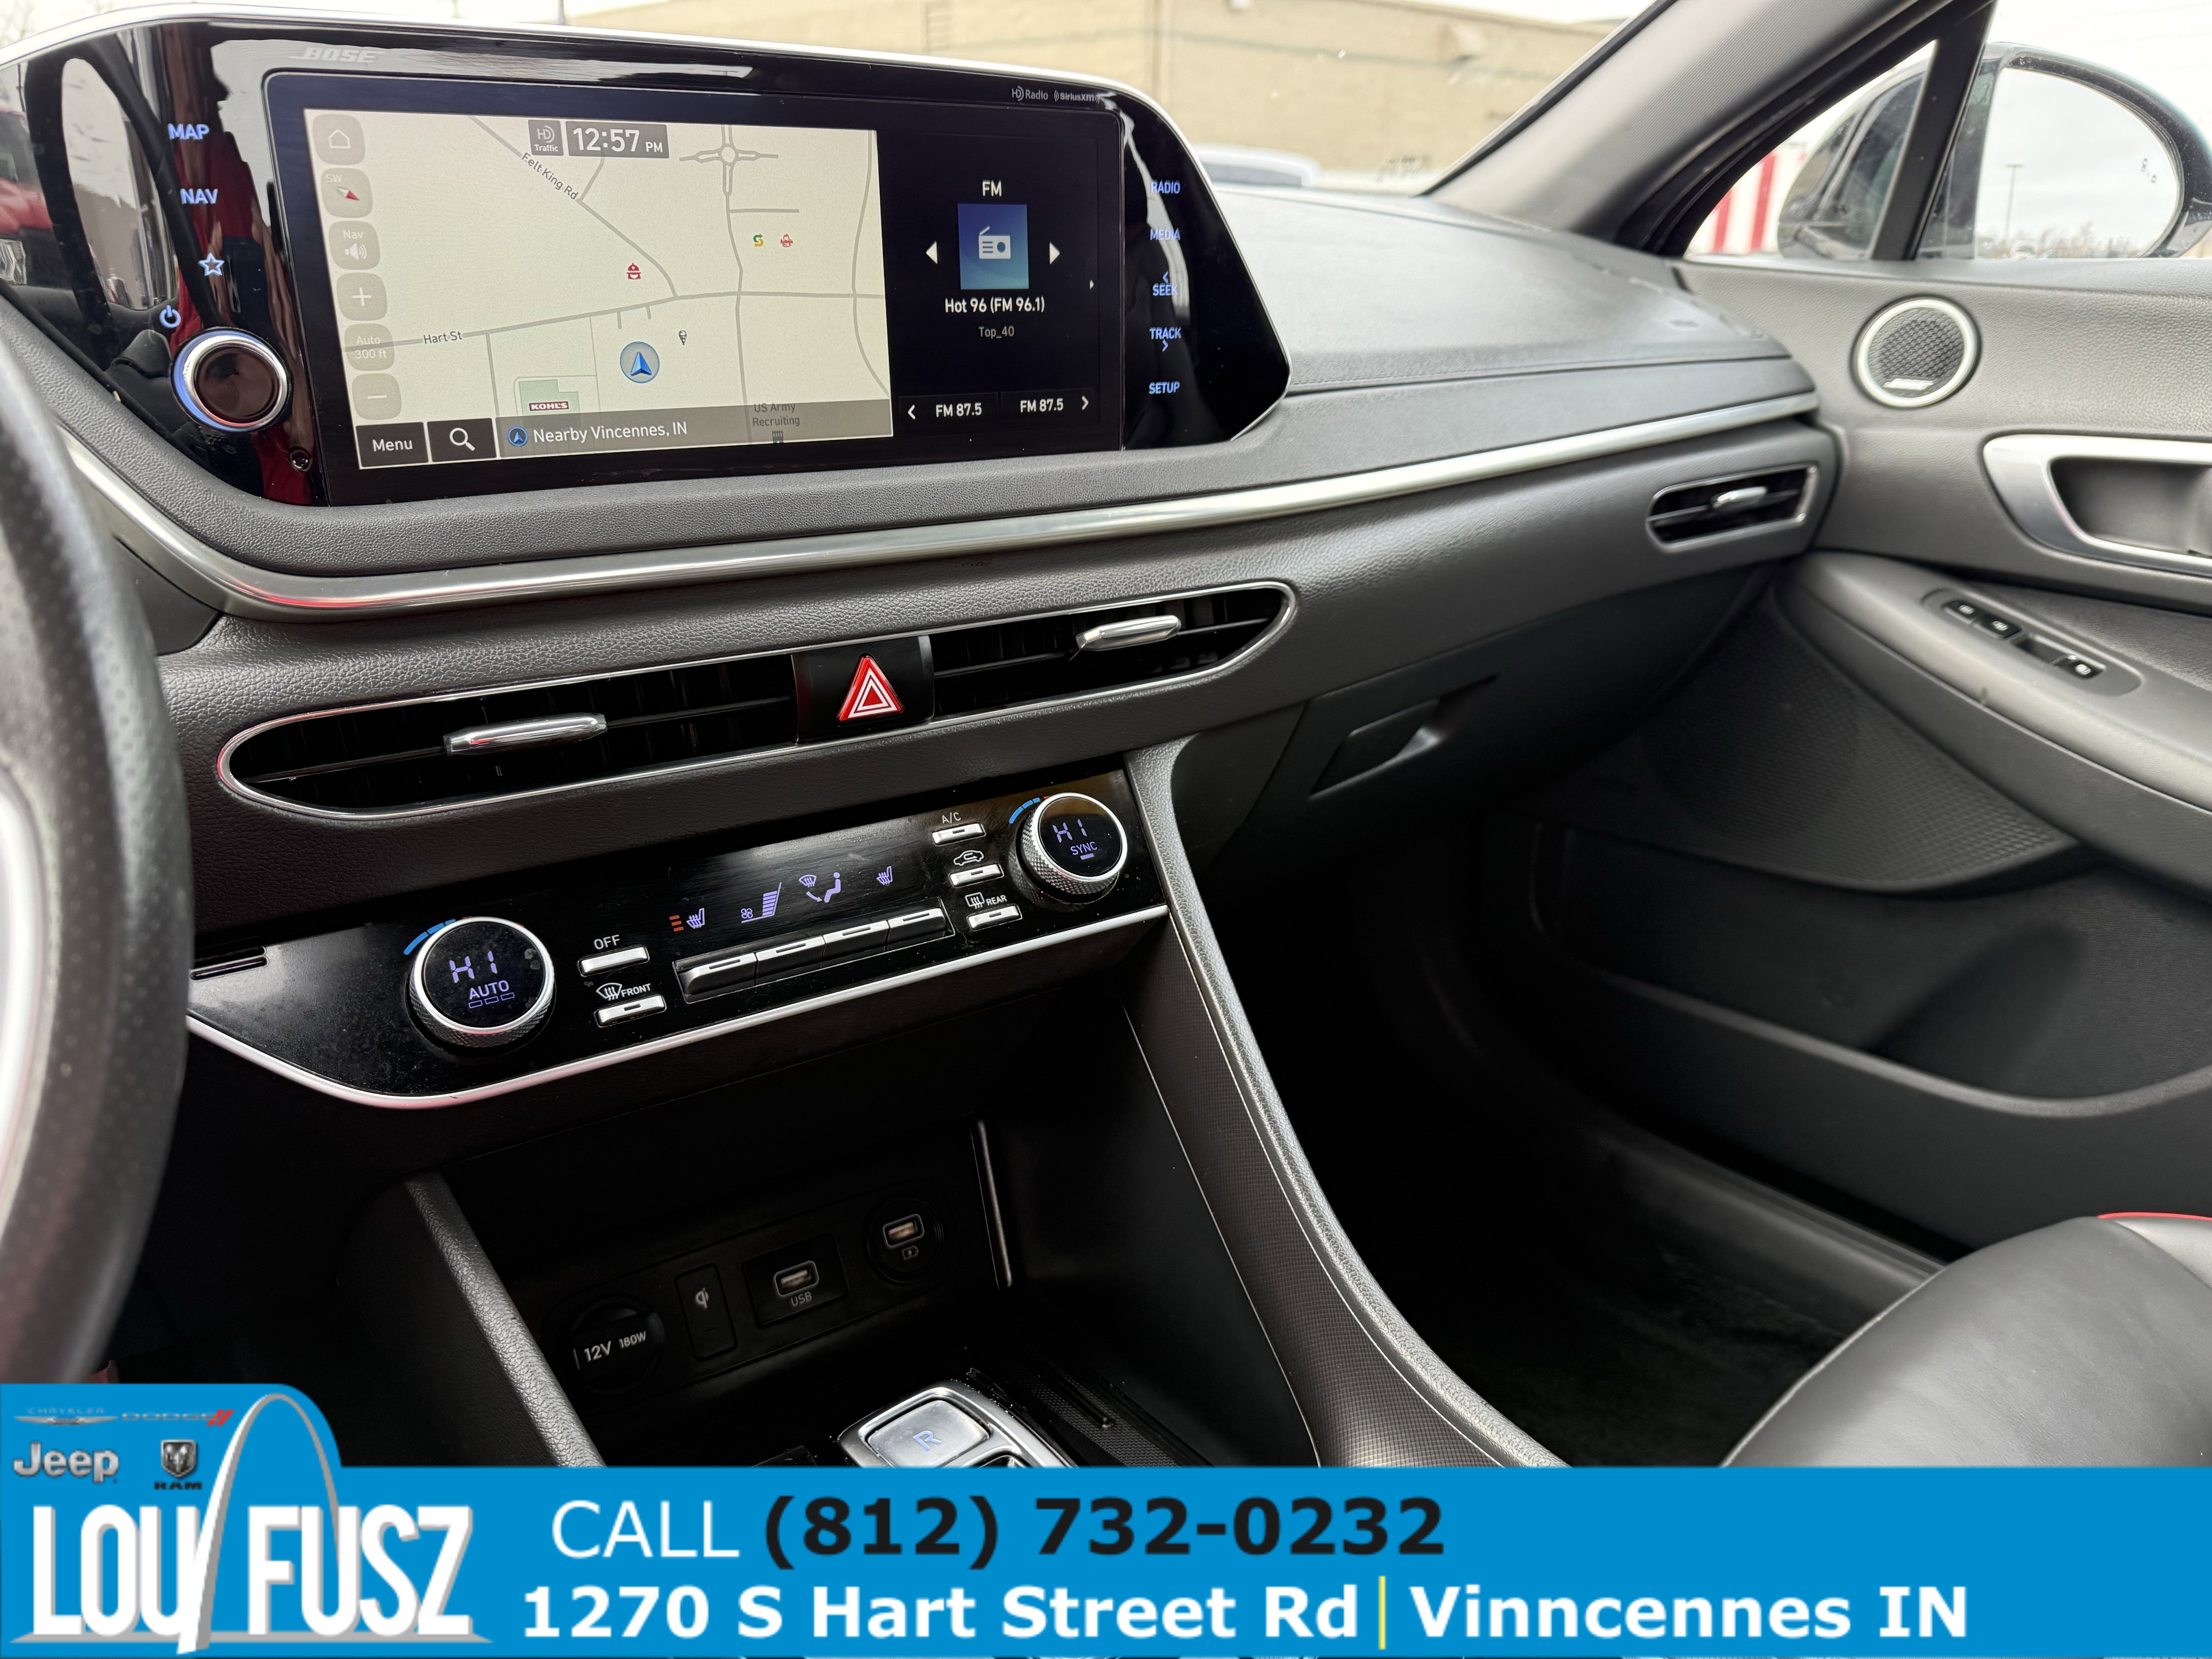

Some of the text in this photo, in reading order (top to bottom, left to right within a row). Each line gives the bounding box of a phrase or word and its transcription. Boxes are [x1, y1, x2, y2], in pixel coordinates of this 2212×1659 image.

[289, 46, 385, 64] BOSE
[1026, 89, 1048, 100] Radio
[168, 123, 210, 140] MAP
[573, 128, 663, 153] 12:57 PM
[326, 173, 342, 183] SW
[522, 152, 578, 199] Felt King Rd
[982, 180, 1002, 196] FM
[1151, 180, 1180, 194] RADIO
[180, 188, 218, 204] NAV
[343, 229, 363, 240] Nav
[1150, 227, 1180, 240] MEDIA
[1152, 284, 1178, 297] SEEK
[945, 297, 1045, 314] Hot 96 (FM 96.1)
[424, 331, 462, 344] Hart St
[979, 326, 1015, 339] Top_40
[1149, 327, 1182, 340] TRACK
[357, 335, 381, 345] Auto
[355, 349, 387, 359] 300 ft
[1149, 382, 1180, 394] SETUP
[531, 402, 568, 410] KOHL'S
[754, 403, 795, 413] US Army
[936, 403, 982, 417] FM 87.5
[1020, 398, 1063, 413] FM 87.5
[753, 416, 800, 426] Recruiting
[533, 421, 687, 443] Nearby Vincennes, IN
[373, 439, 413, 452] Menu
[942, 812, 961, 824] A/C
[1070, 841, 1097, 855] SYNC
[986, 895, 1007, 906] REAR
[594, 934, 620, 950] OFF
[469, 980, 509, 1000] AUTO
[621, 983, 651, 998] FRONT
[791, 1291, 812, 1307] USB
[584, 1331, 646, 1363] 12V 180W
[913, 1430, 942, 1451] R
